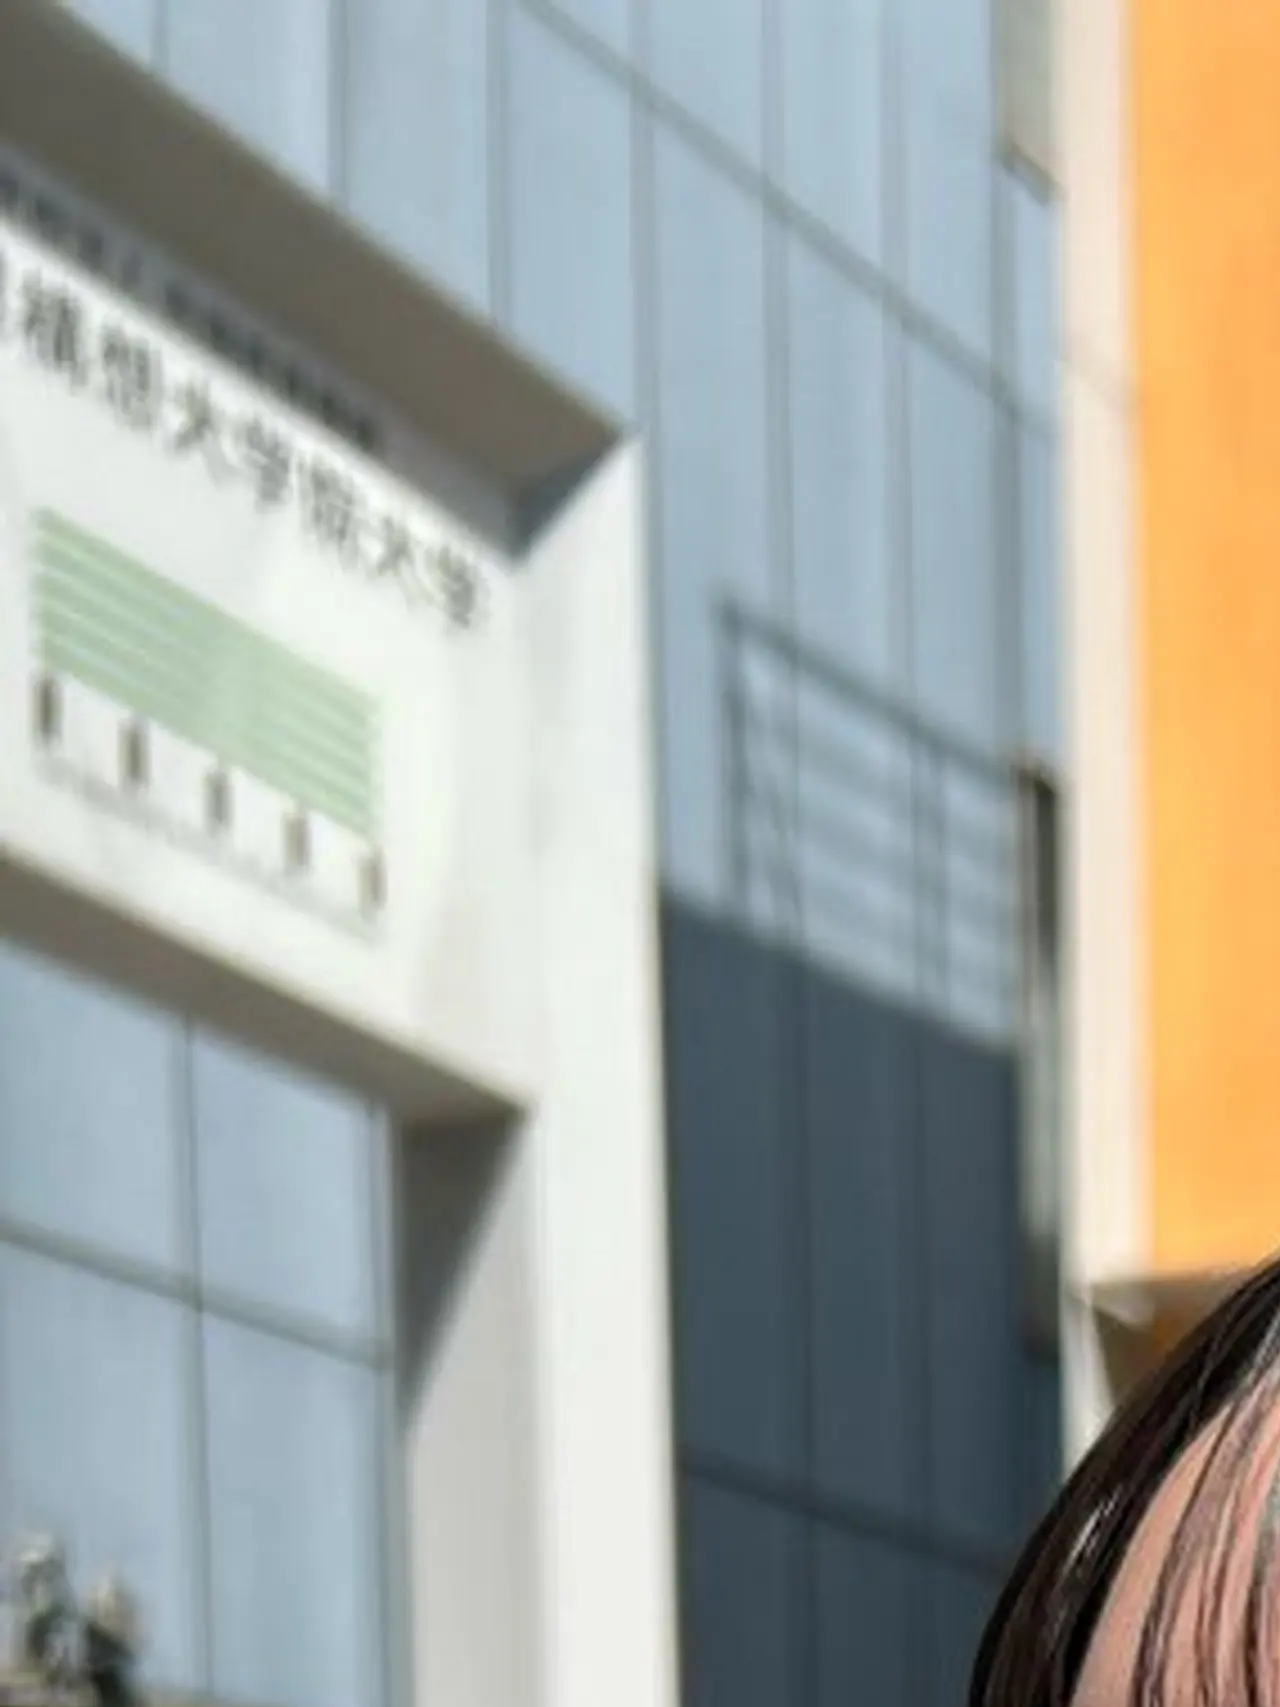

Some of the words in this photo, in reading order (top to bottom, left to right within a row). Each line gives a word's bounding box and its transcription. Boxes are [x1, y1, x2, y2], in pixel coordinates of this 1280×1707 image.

[0, 255, 490, 638] 構想大学院大学
